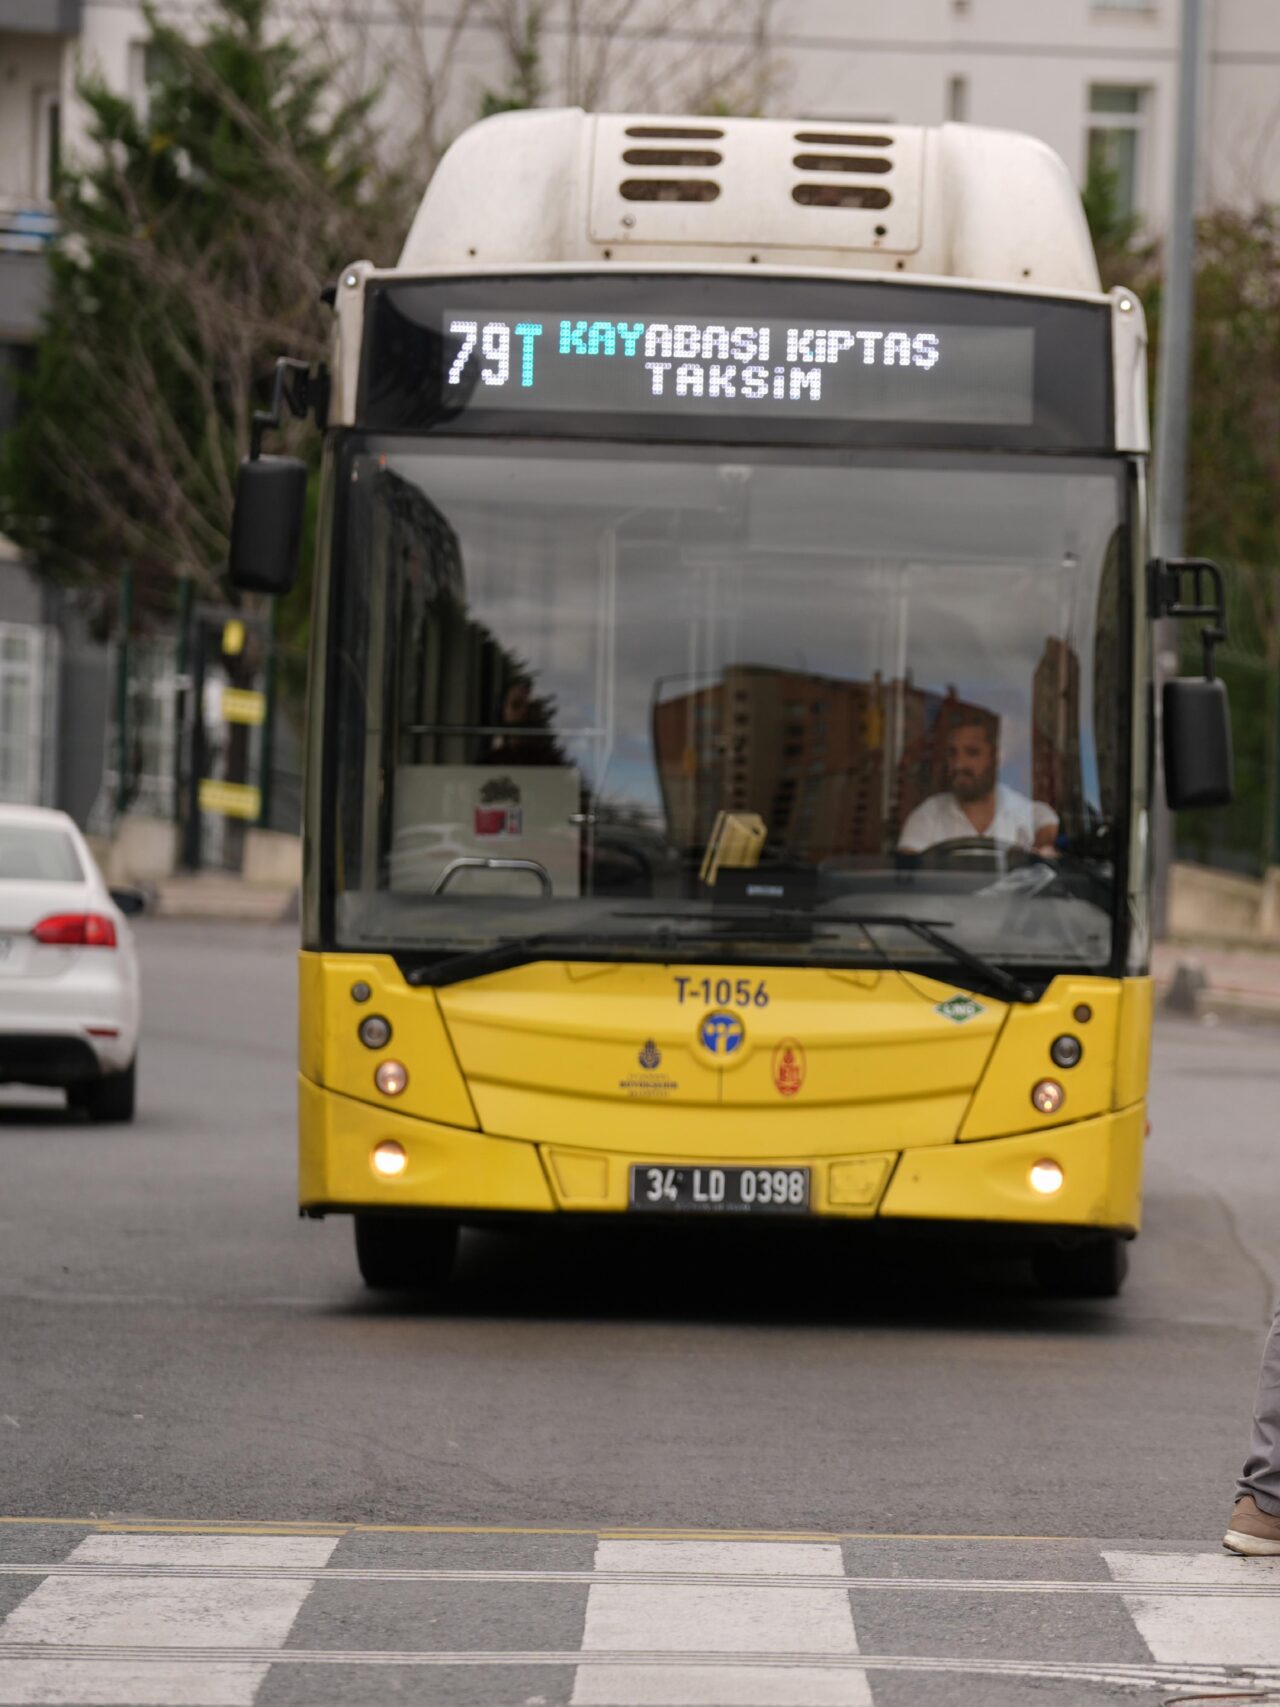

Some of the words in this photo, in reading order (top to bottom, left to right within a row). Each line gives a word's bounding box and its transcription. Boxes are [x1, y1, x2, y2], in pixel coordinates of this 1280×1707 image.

[448, 321, 542, 387] 79T
[559, 320, 770, 363] KAYABAŞI
[645, 362, 821, 400] TAKSİM
[674, 976, 769, 1008] T-1056
[646, 1168, 679, 1202] 34
[692, 1169, 726, 1202] LD
[740, 1170, 805, 1204] 0398
